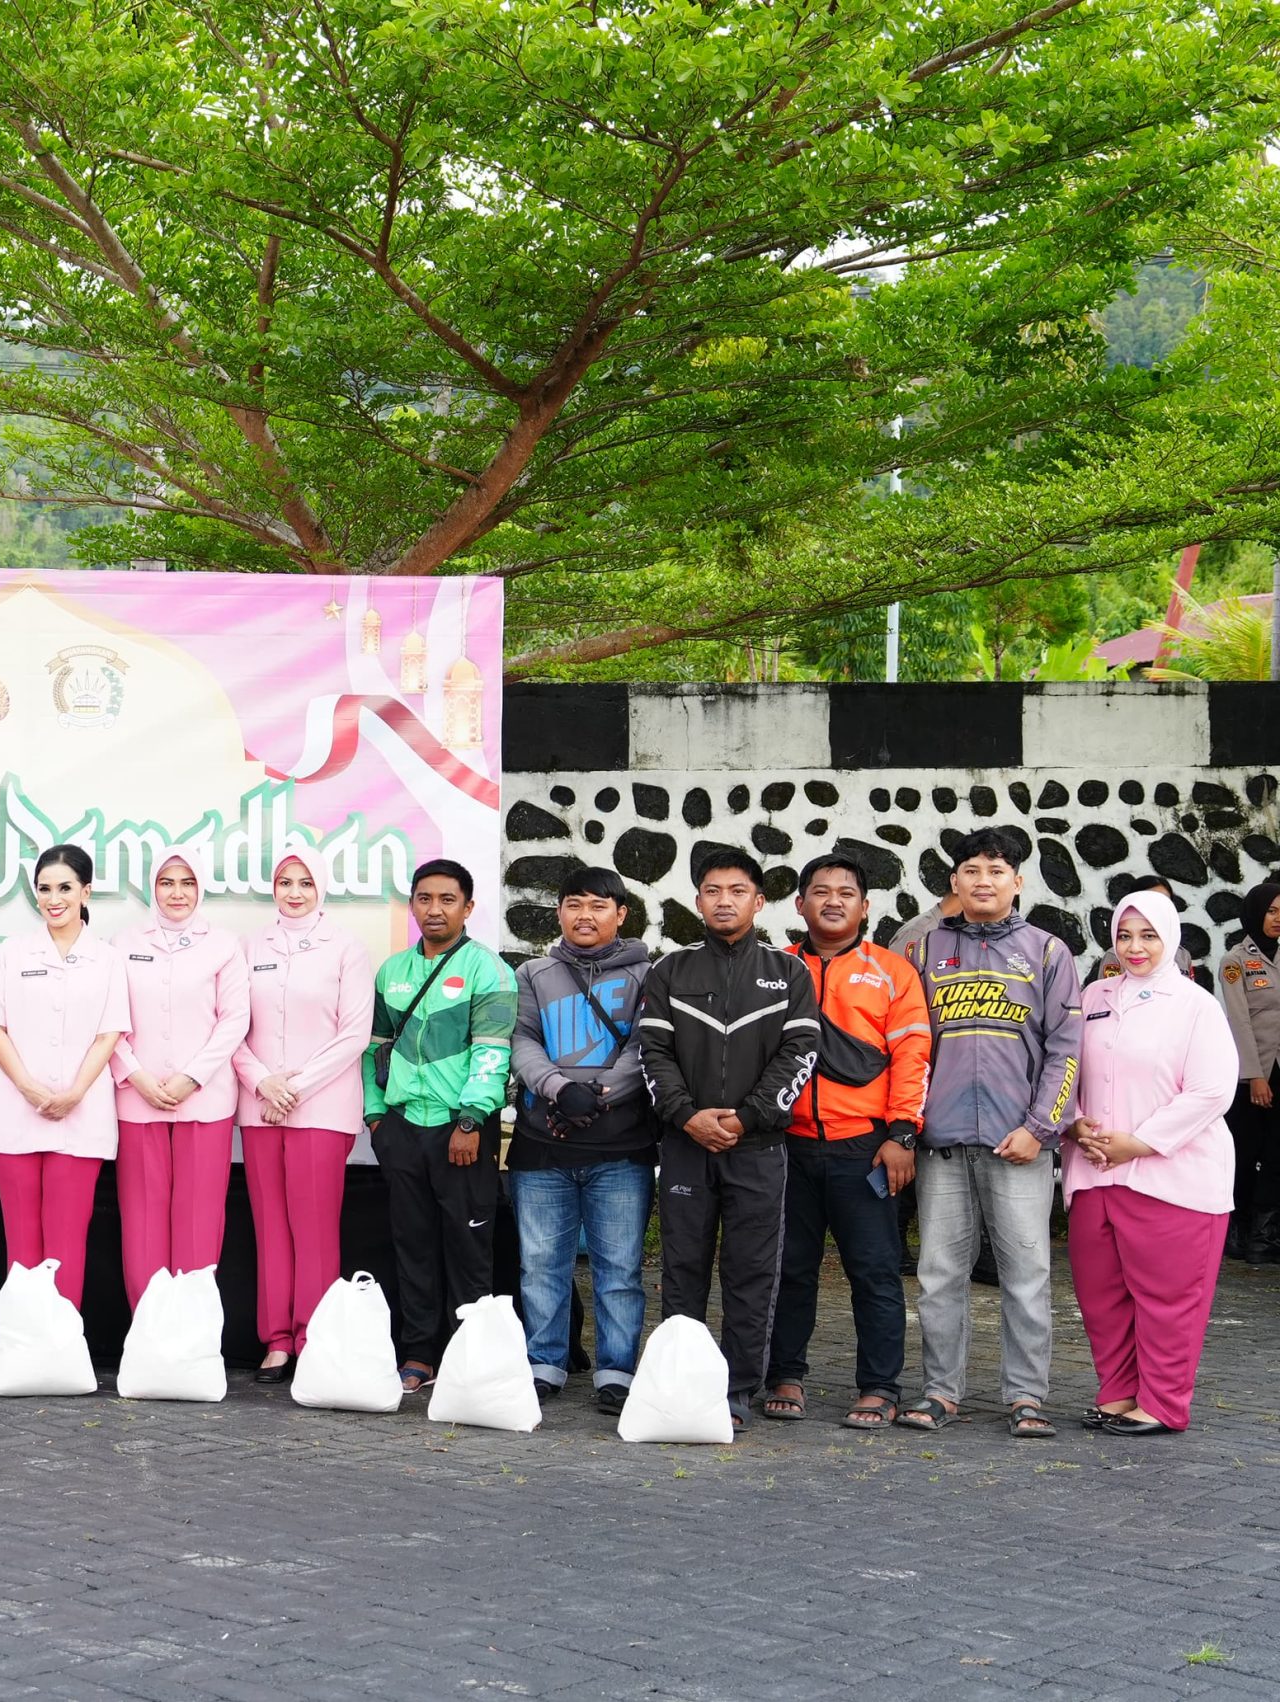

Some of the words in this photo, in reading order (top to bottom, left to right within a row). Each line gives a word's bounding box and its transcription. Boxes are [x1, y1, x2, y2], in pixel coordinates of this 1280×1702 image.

[756, 978, 788, 990] Grab
[931, 981, 1007, 1008] KURIR
[938, 1000, 1032, 1025] MAMUJU
[777, 1051, 817, 1111] Grab
